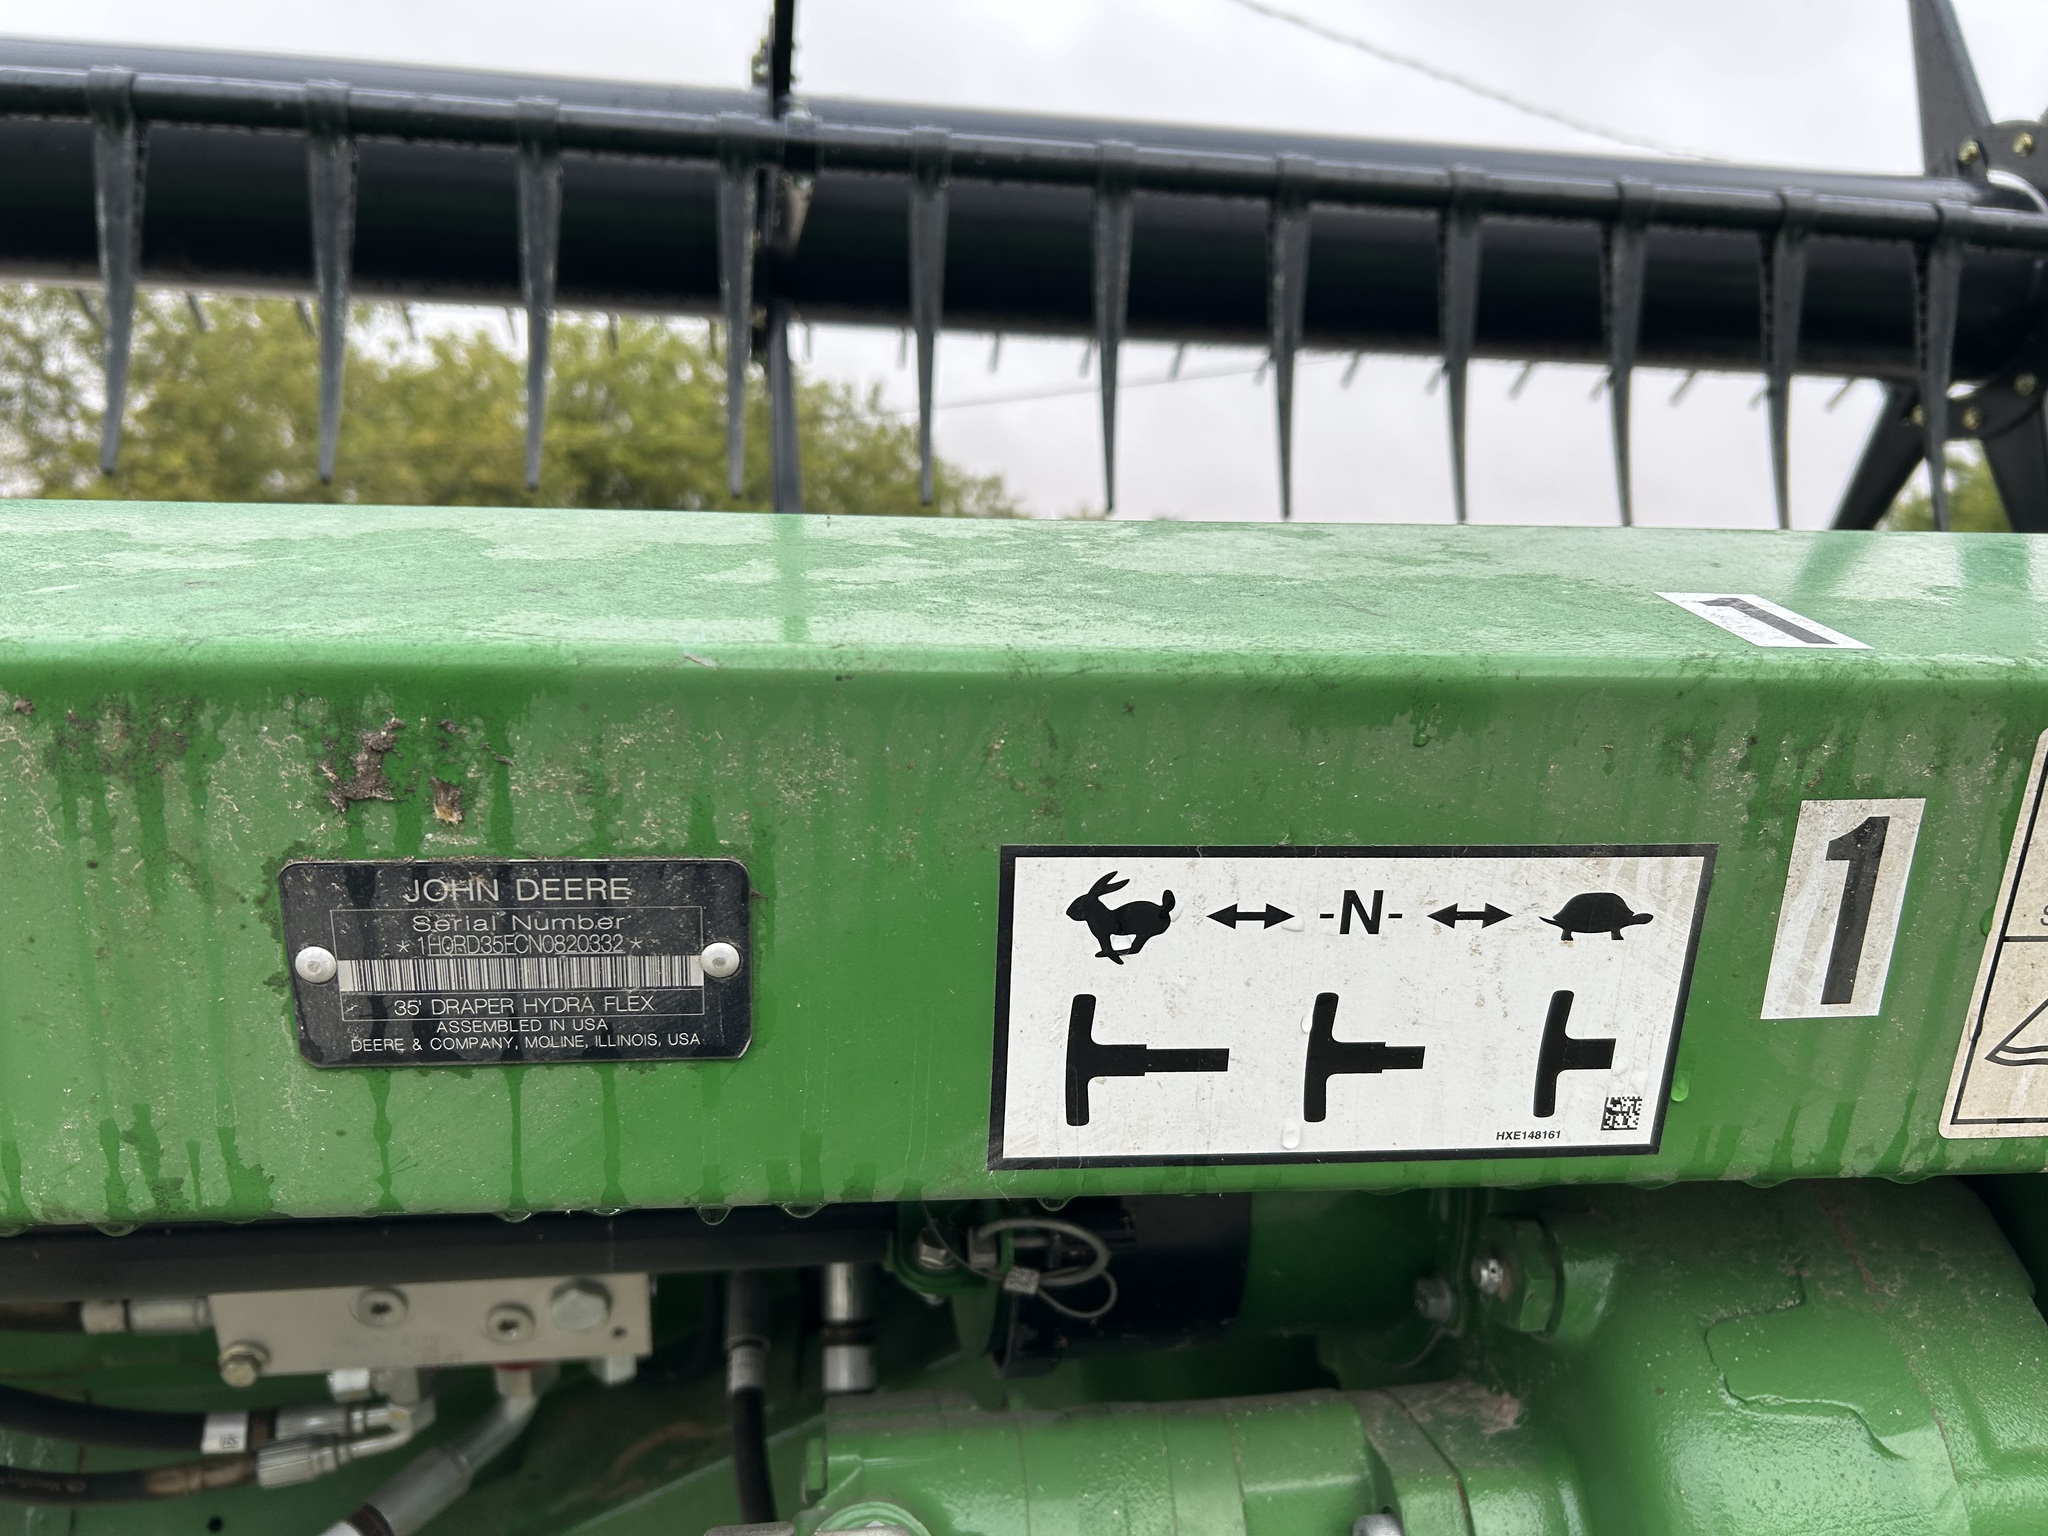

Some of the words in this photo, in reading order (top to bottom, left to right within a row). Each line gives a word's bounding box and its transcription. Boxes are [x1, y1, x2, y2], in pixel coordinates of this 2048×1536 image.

[1698, 597, 1839, 645] 1
[404, 878, 499, 902] JOHN
[516, 877, 630, 901] DEERE
[1820, 815, 1891, 1005] 1
[412, 914, 497, 932] Serial
[512, 914, 625, 931] Number
[394, 998, 422, 1016] 35'
[431, 997, 515, 1015] DRAPER
[524, 996, 595, 1014] HYDRA
[605, 995, 655, 1012] FLEX
[436, 1019, 542, 1034] ASSEMBLED
[550, 1019, 565, 1032] IN
[572, 1018, 609, 1031] USA
[351, 1037, 406, 1053] DEERE
[412, 1037, 423, 1051] &
[430, 1036, 519, 1051] COMPANY,
[525, 1034, 589, 1049] MOLINE,
[595, 1033, 662, 1048] ILLINOIS,
[668, 1032, 702, 1046] USA
[1496, 1130, 1562, 1141] HXE148161
